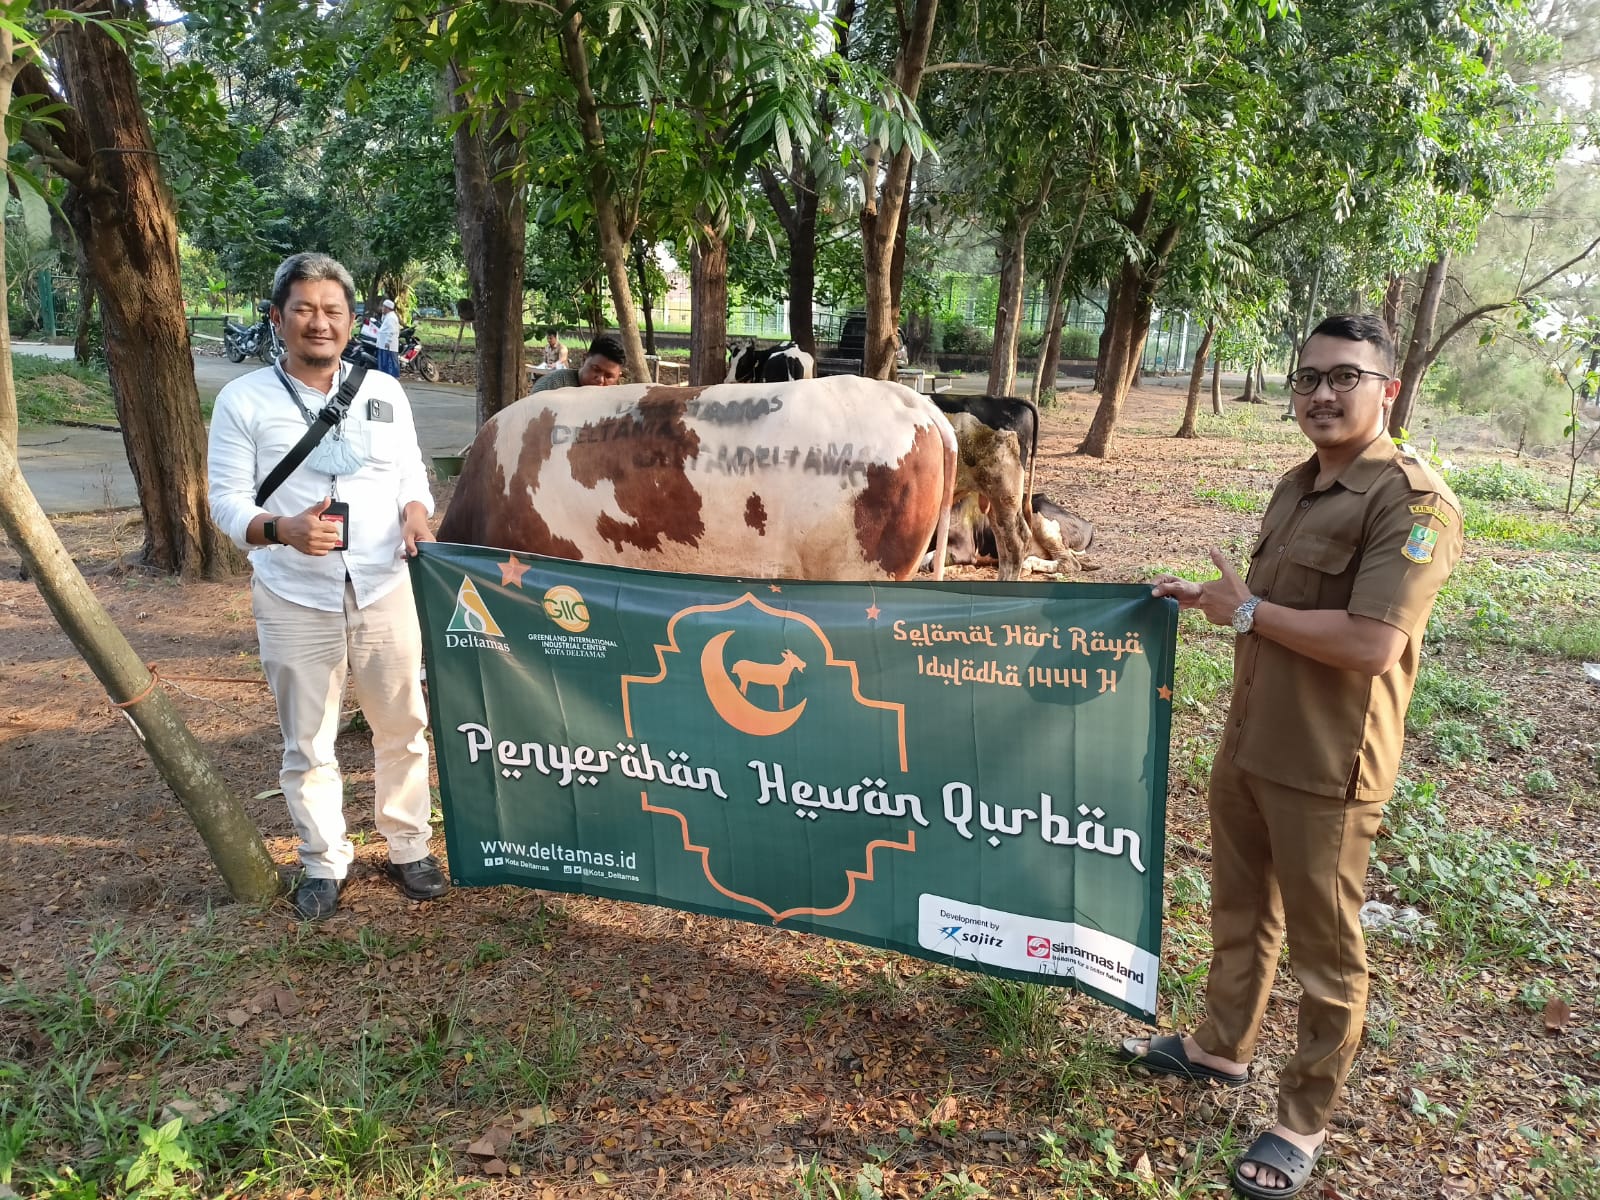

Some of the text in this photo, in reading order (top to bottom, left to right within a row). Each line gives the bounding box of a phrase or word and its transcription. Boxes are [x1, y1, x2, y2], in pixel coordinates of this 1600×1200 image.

[544, 598, 590, 623] GIIC
[446, 634, 510, 652] Deltamas
[528, 633, 618, 647] GREENLAND INTERNATIONAL
[542, 641, 607, 652] INDUSTRIAL CENTER
[544, 648, 606, 658] KOTA DELTAMAS
[1027, 666, 1087, 689] 1444
[1096, 669, 1117, 693] H
[480, 840, 637, 870] www.deltamas.id
[504, 857, 550, 871] Kota Deltamas
[940, 909, 1000, 931] Development by
[962, 931, 1003, 948] sojitz
[1051, 942, 1144, 985] sinarmas land
